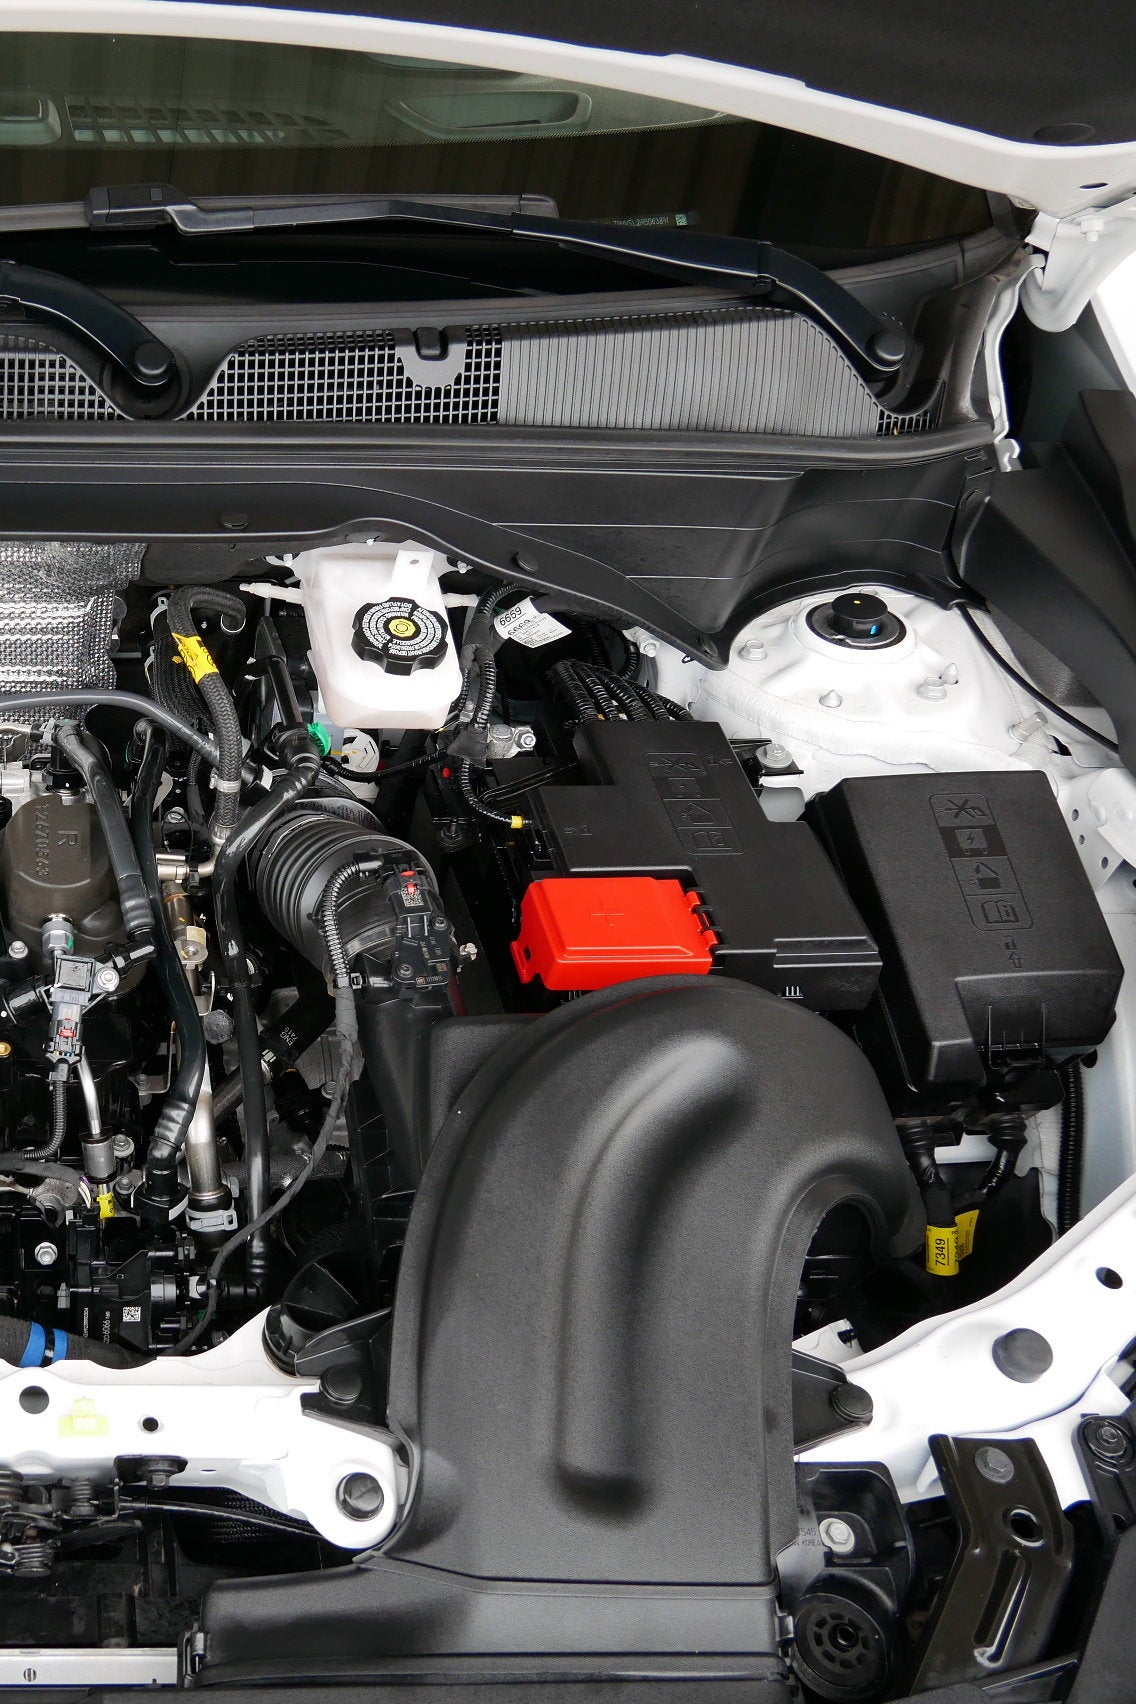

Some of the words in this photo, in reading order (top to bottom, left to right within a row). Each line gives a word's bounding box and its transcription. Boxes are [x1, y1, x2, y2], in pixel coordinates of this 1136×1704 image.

[499, 606, 522, 627] 6669
[57, 830, 79, 846] R
[935, 1238, 946, 1267] 7349
